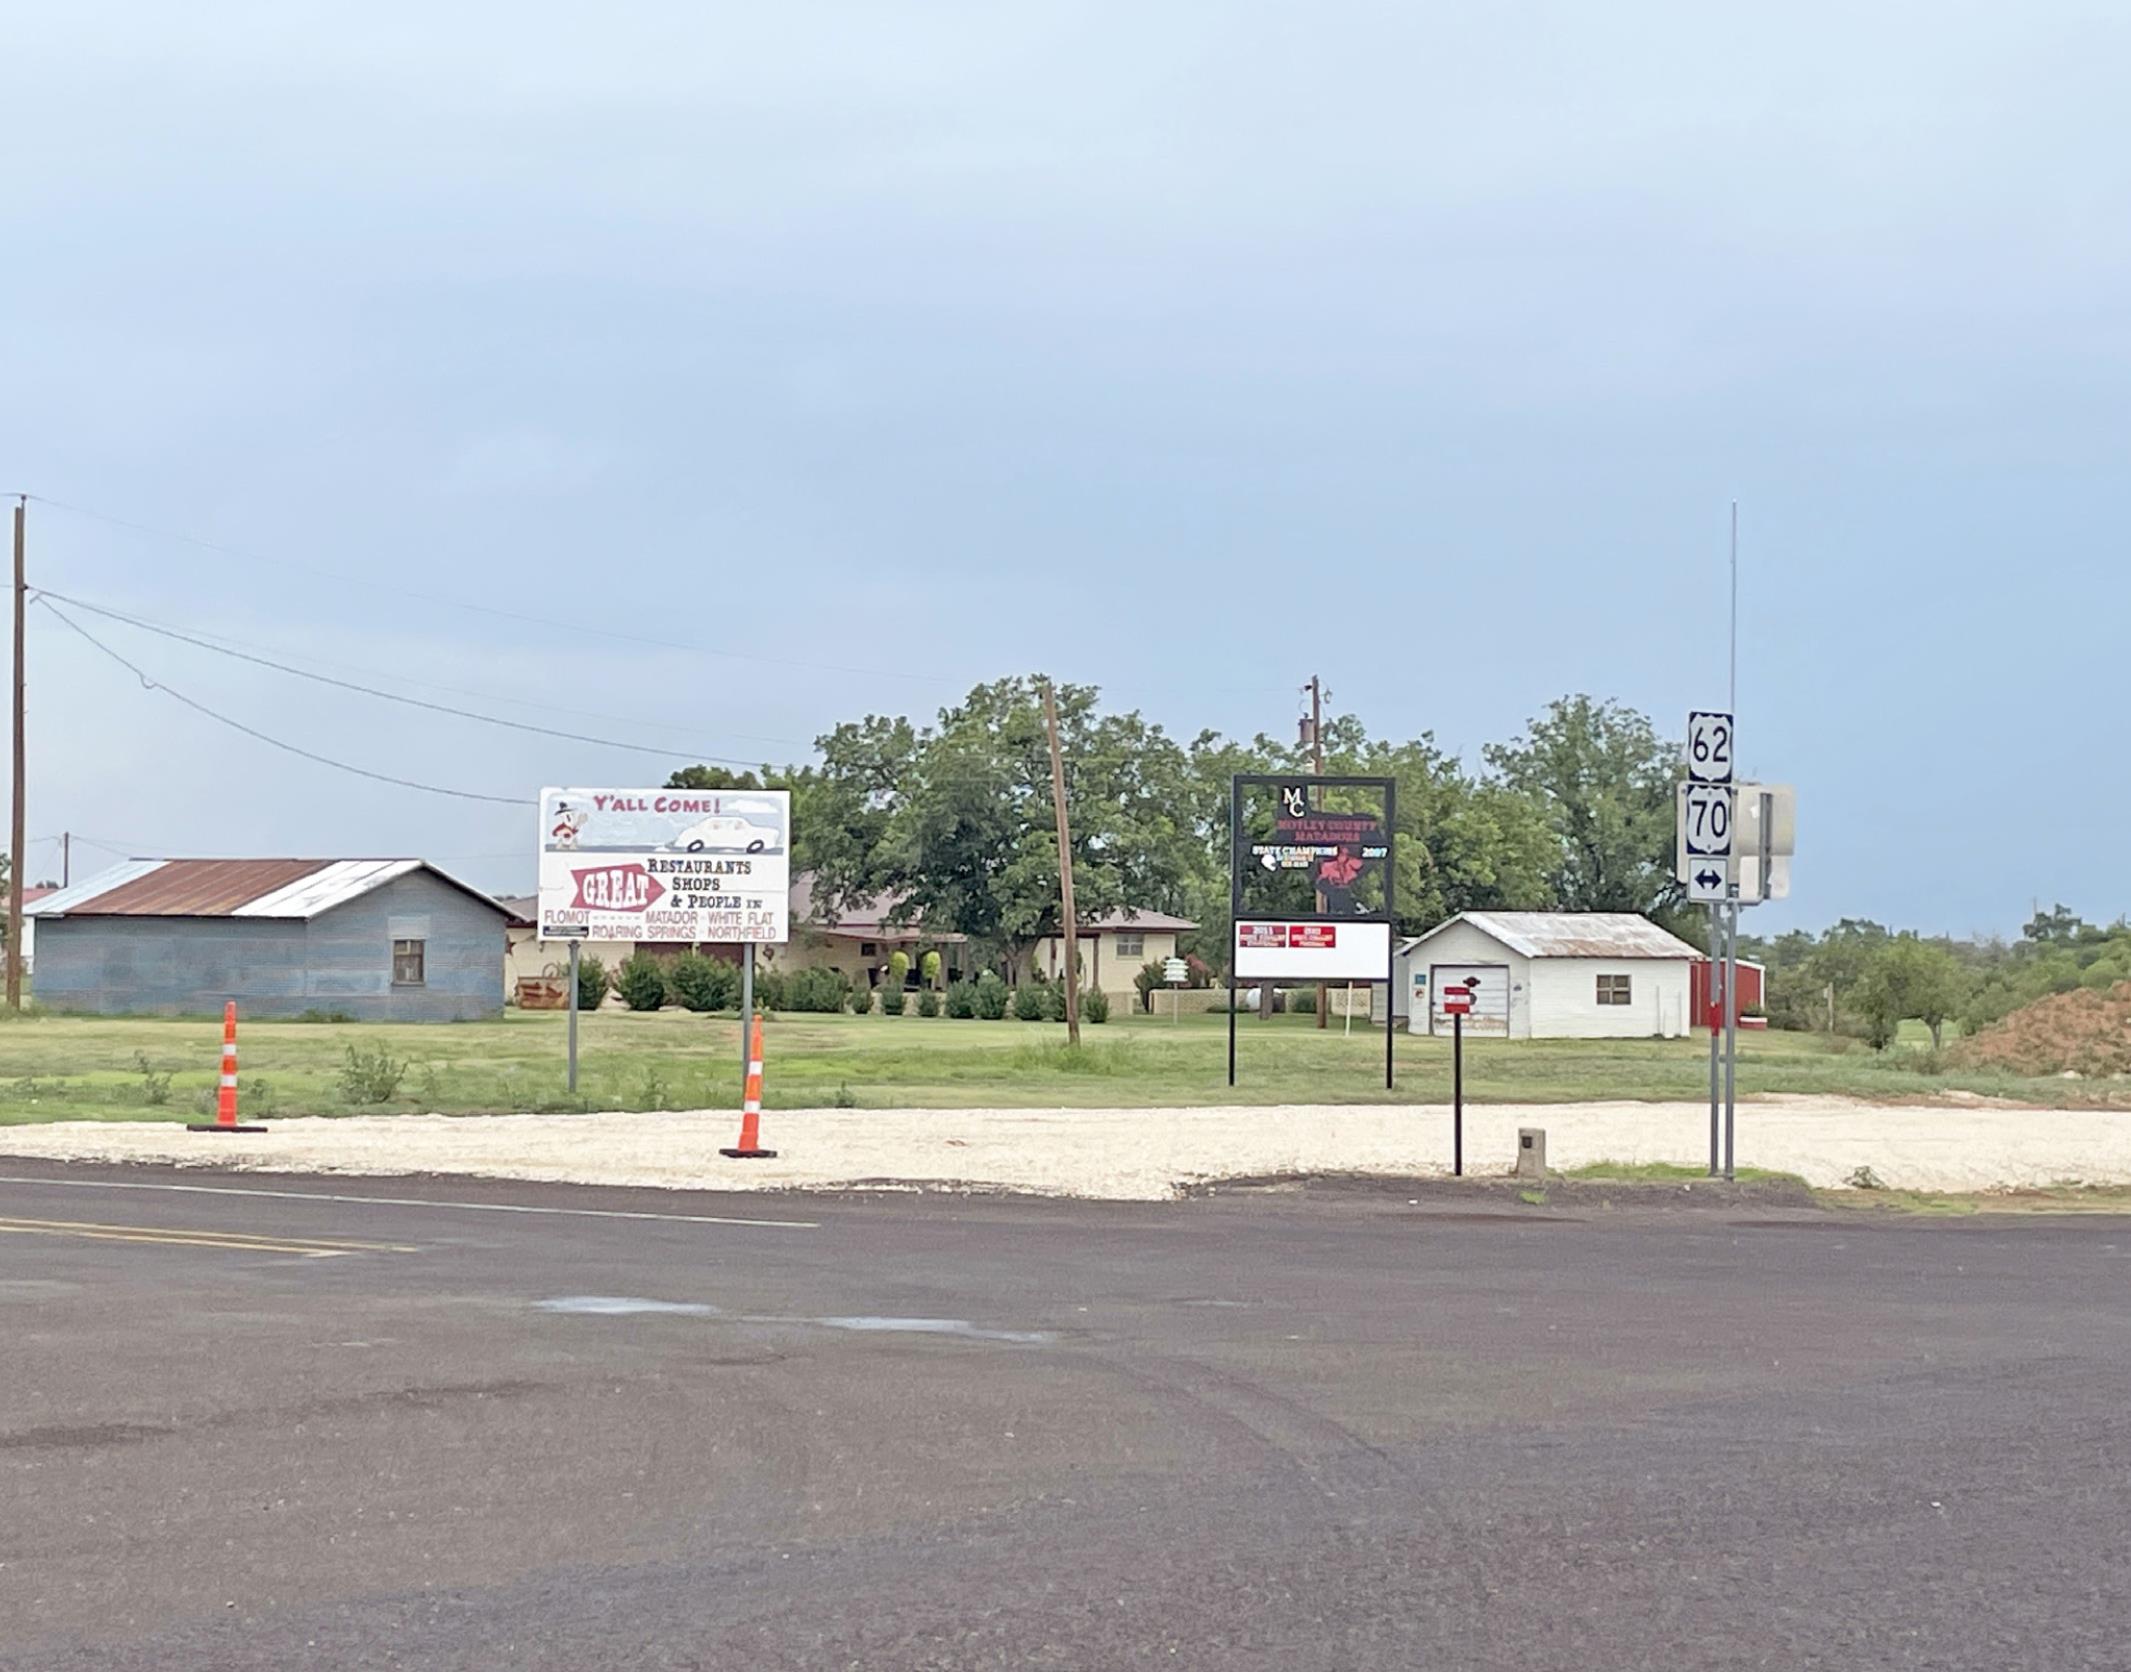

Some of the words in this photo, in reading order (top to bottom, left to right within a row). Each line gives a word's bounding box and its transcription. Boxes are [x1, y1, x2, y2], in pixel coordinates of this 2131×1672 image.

[1693, 726, 1728, 762] 62
[593, 795, 648, 812] Y'ALL
[654, 796, 720, 813] COME!
[1691, 801, 1727, 838] 70
[647, 858, 752, 874] RESTAURANTS
[582, 869, 650, 909] GREAT
[672, 877, 720, 890] SHOPS
[671, 895, 682, 907] &
[688, 895, 742, 908] PEOPLE
[746, 899, 763, 908] IN
[544, 910, 591, 924] FLOMOT
[645, 911, 698, 924] MATADOR
[708, 911, 743, 925] WHITE
[748, 912, 774, 925] FLAT
[592, 925, 643, 938] ROARING
[647, 925, 696, 939] SPRINGS
[708, 926, 777, 940] NORTHFIELD
